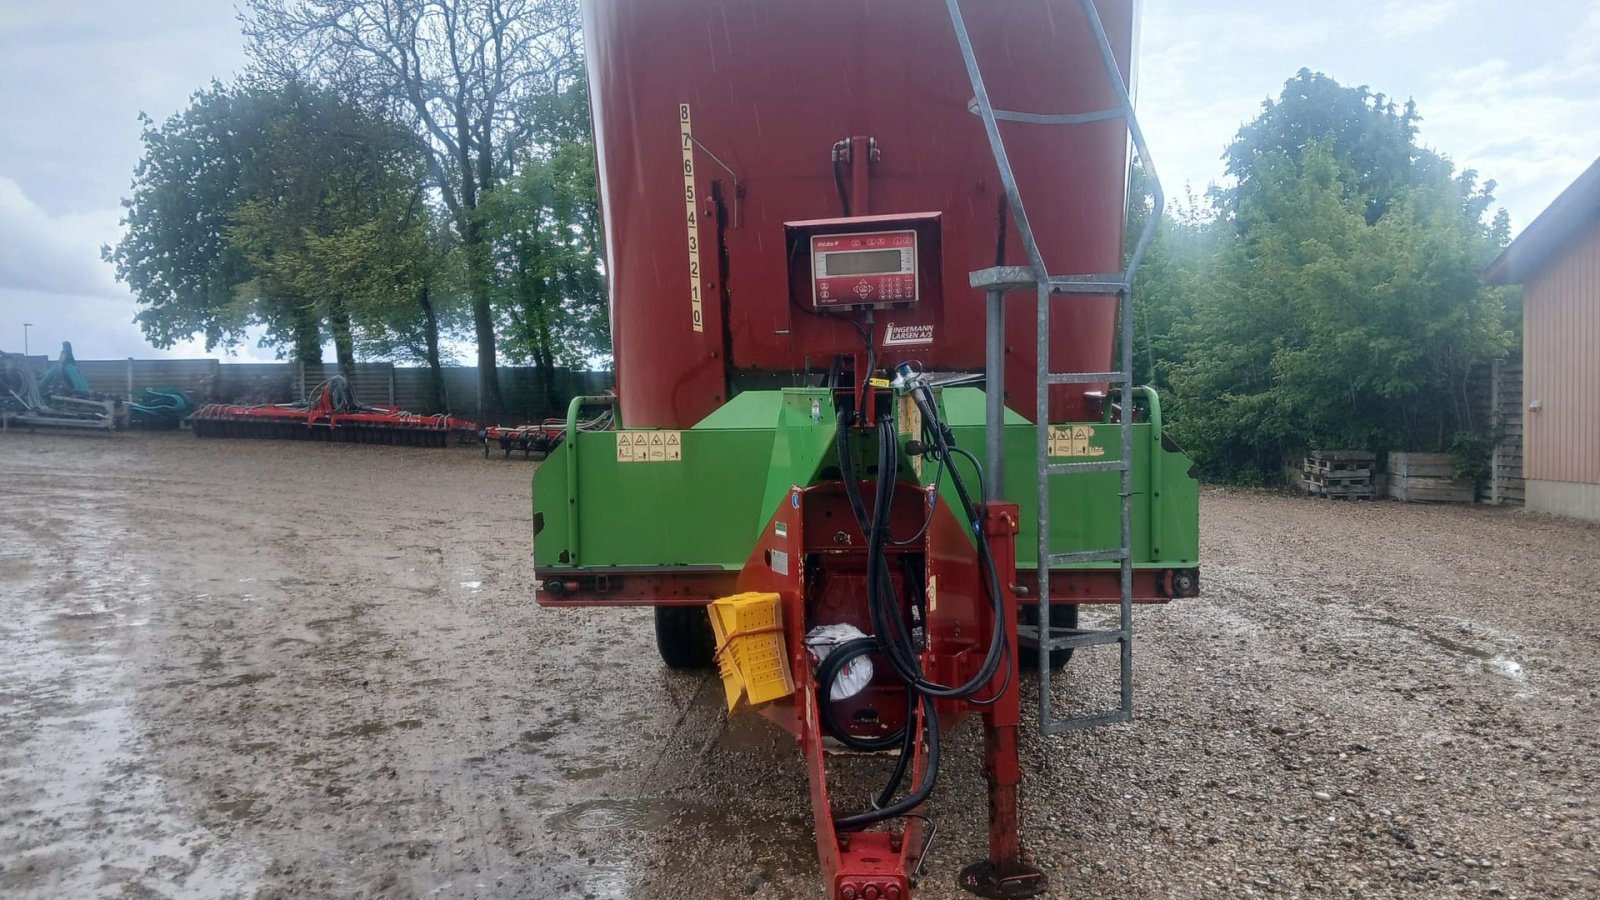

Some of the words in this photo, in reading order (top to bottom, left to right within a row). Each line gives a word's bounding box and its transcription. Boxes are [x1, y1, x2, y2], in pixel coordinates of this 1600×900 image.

[681, 105, 688, 120] 8
[682, 132, 690, 147] 7
[684, 159, 692, 173] 6
[686, 185, 694, 199] 5
[688, 211, 696, 224] 4
[689, 236, 697, 250] 3
[691, 262, 698, 275] 2
[692, 286, 698, 299] 1
[693, 310, 701, 323] 0
[893, 324, 934, 333] INGEMANN
